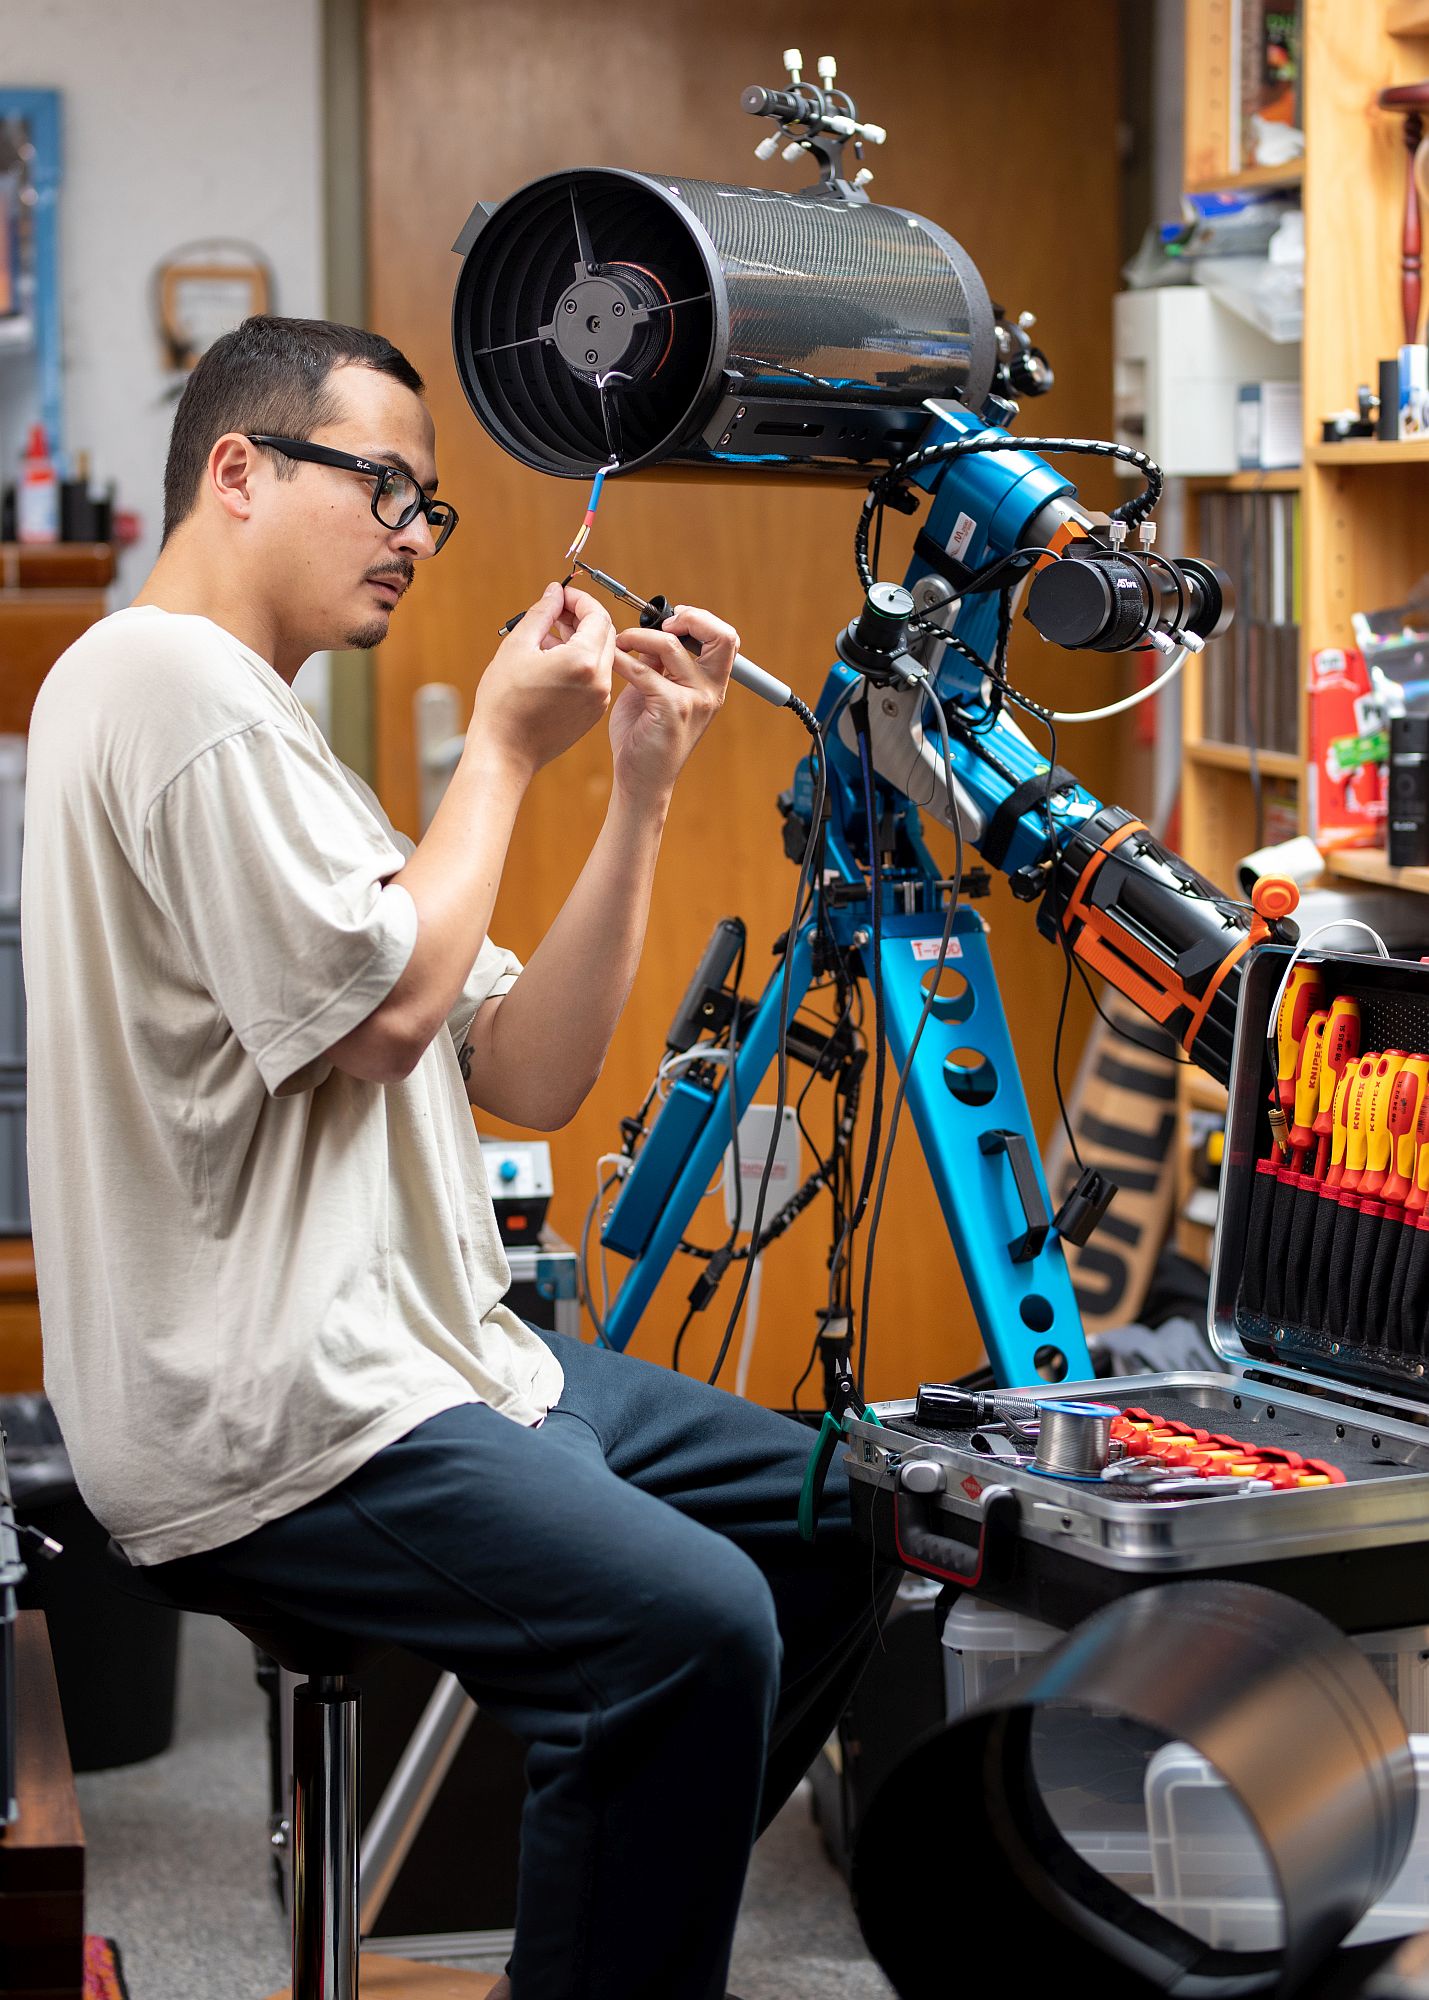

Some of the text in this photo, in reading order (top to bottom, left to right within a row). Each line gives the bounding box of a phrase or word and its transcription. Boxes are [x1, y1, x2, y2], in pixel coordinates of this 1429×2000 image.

[913, 942, 960, 957] T-PD
[1308, 1042, 1322, 1089] KNIPEX
[1353, 1082, 1366, 1130] KNIPEX
[1369, 1081, 1381, 1132] KNIPEX
